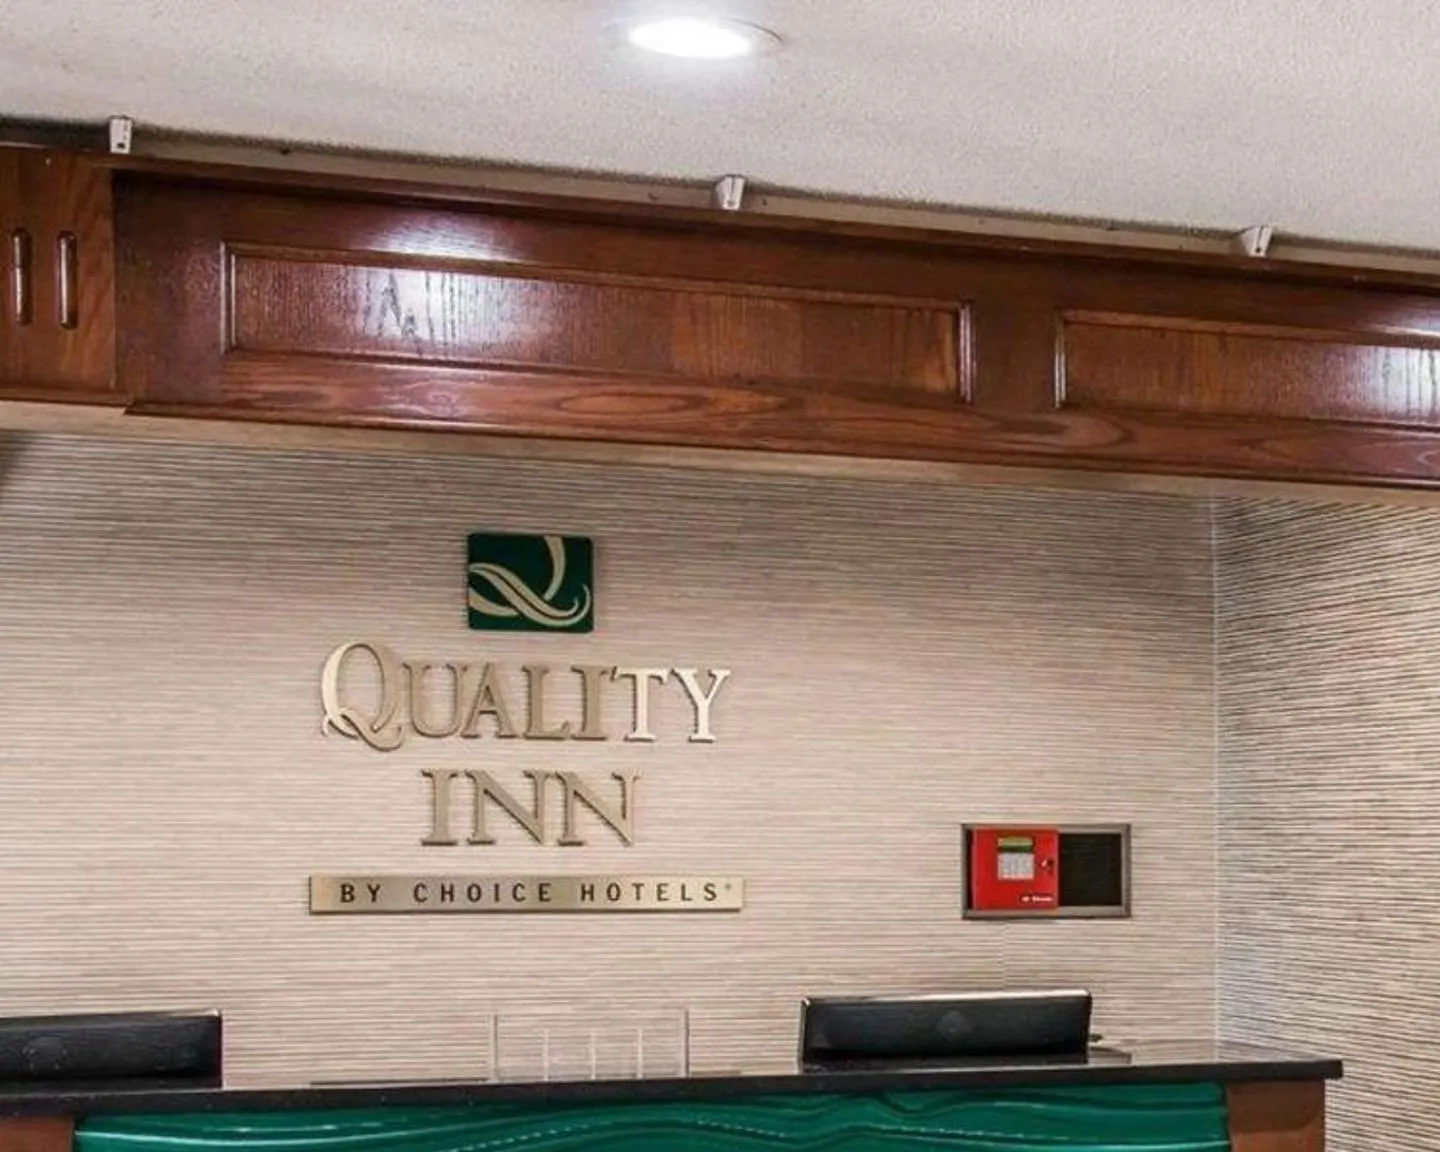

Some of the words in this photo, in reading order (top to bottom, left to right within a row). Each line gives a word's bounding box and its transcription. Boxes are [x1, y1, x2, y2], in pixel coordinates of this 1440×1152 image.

[321, 640, 732, 752] QUALITY
[420, 767, 642, 847] INN
[339, 883, 383, 903] BY
[413, 882, 553, 903] CHOICE
